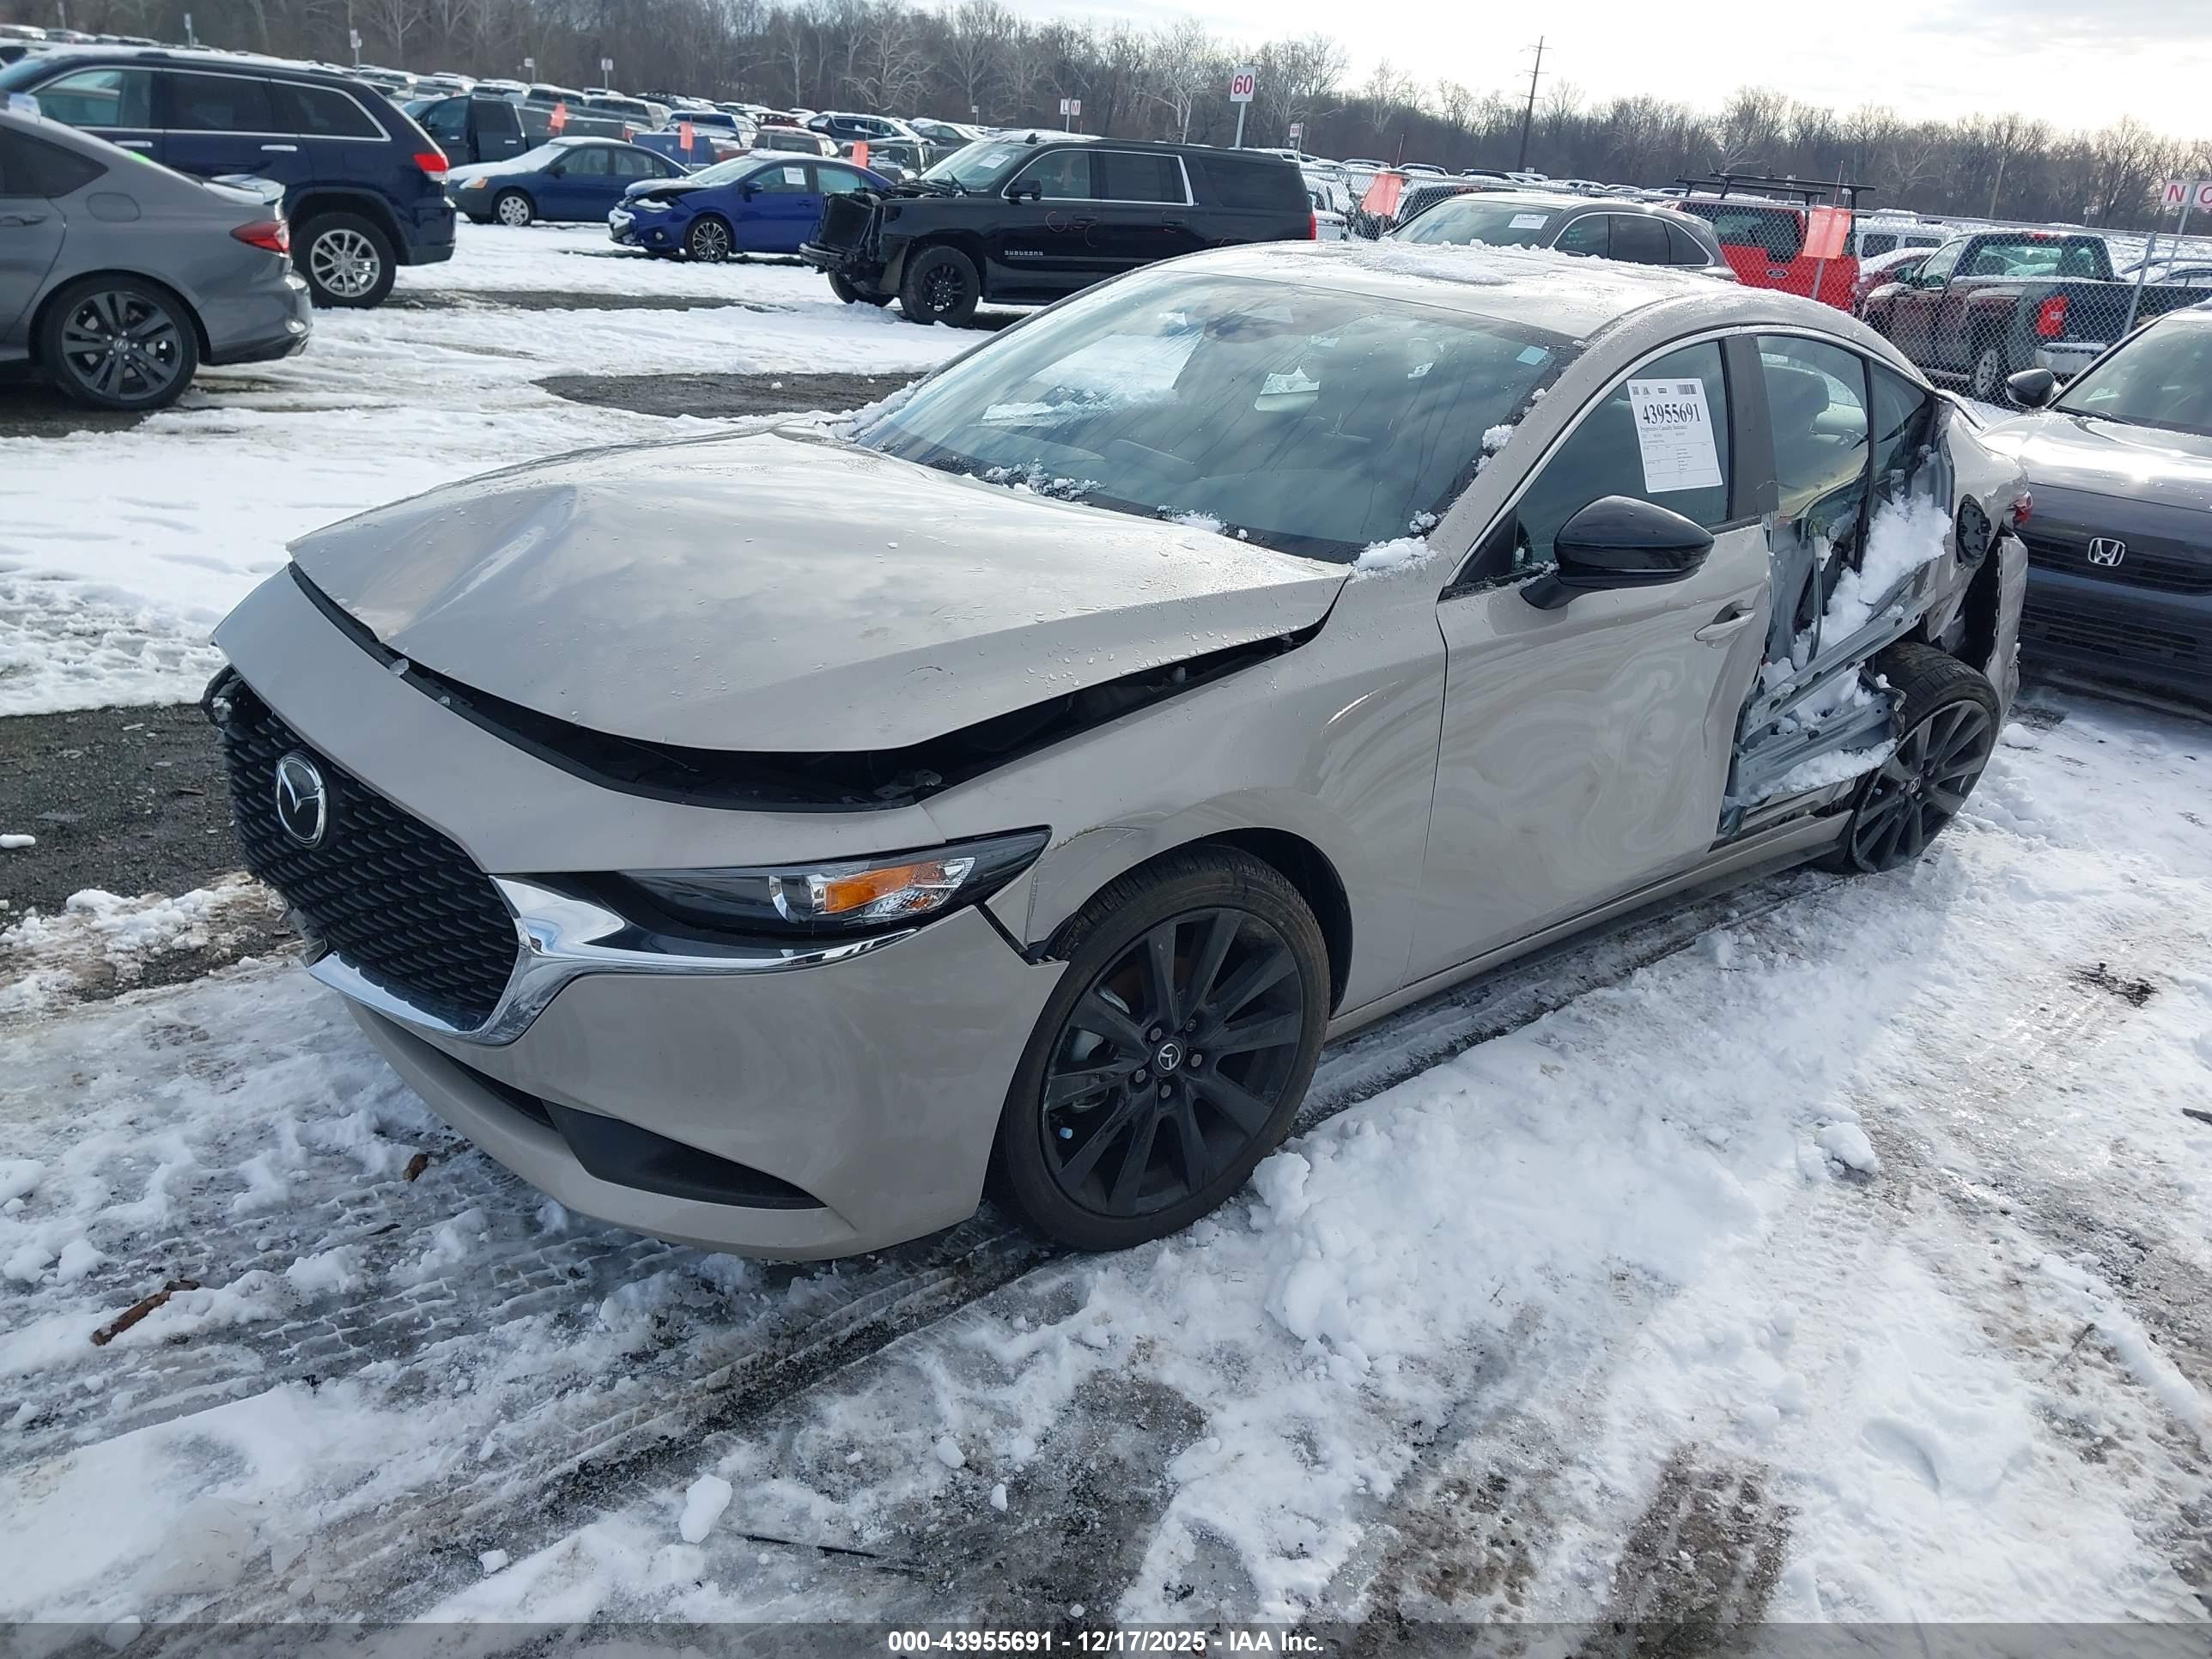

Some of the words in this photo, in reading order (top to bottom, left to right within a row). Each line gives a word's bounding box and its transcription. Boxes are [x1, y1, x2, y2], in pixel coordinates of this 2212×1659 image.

[1234, 75, 1254, 94] 60
[1072, 102, 1079, 112] M
[2167, 185, 2187, 203] N
[1643, 402, 1702, 424] 43955691
